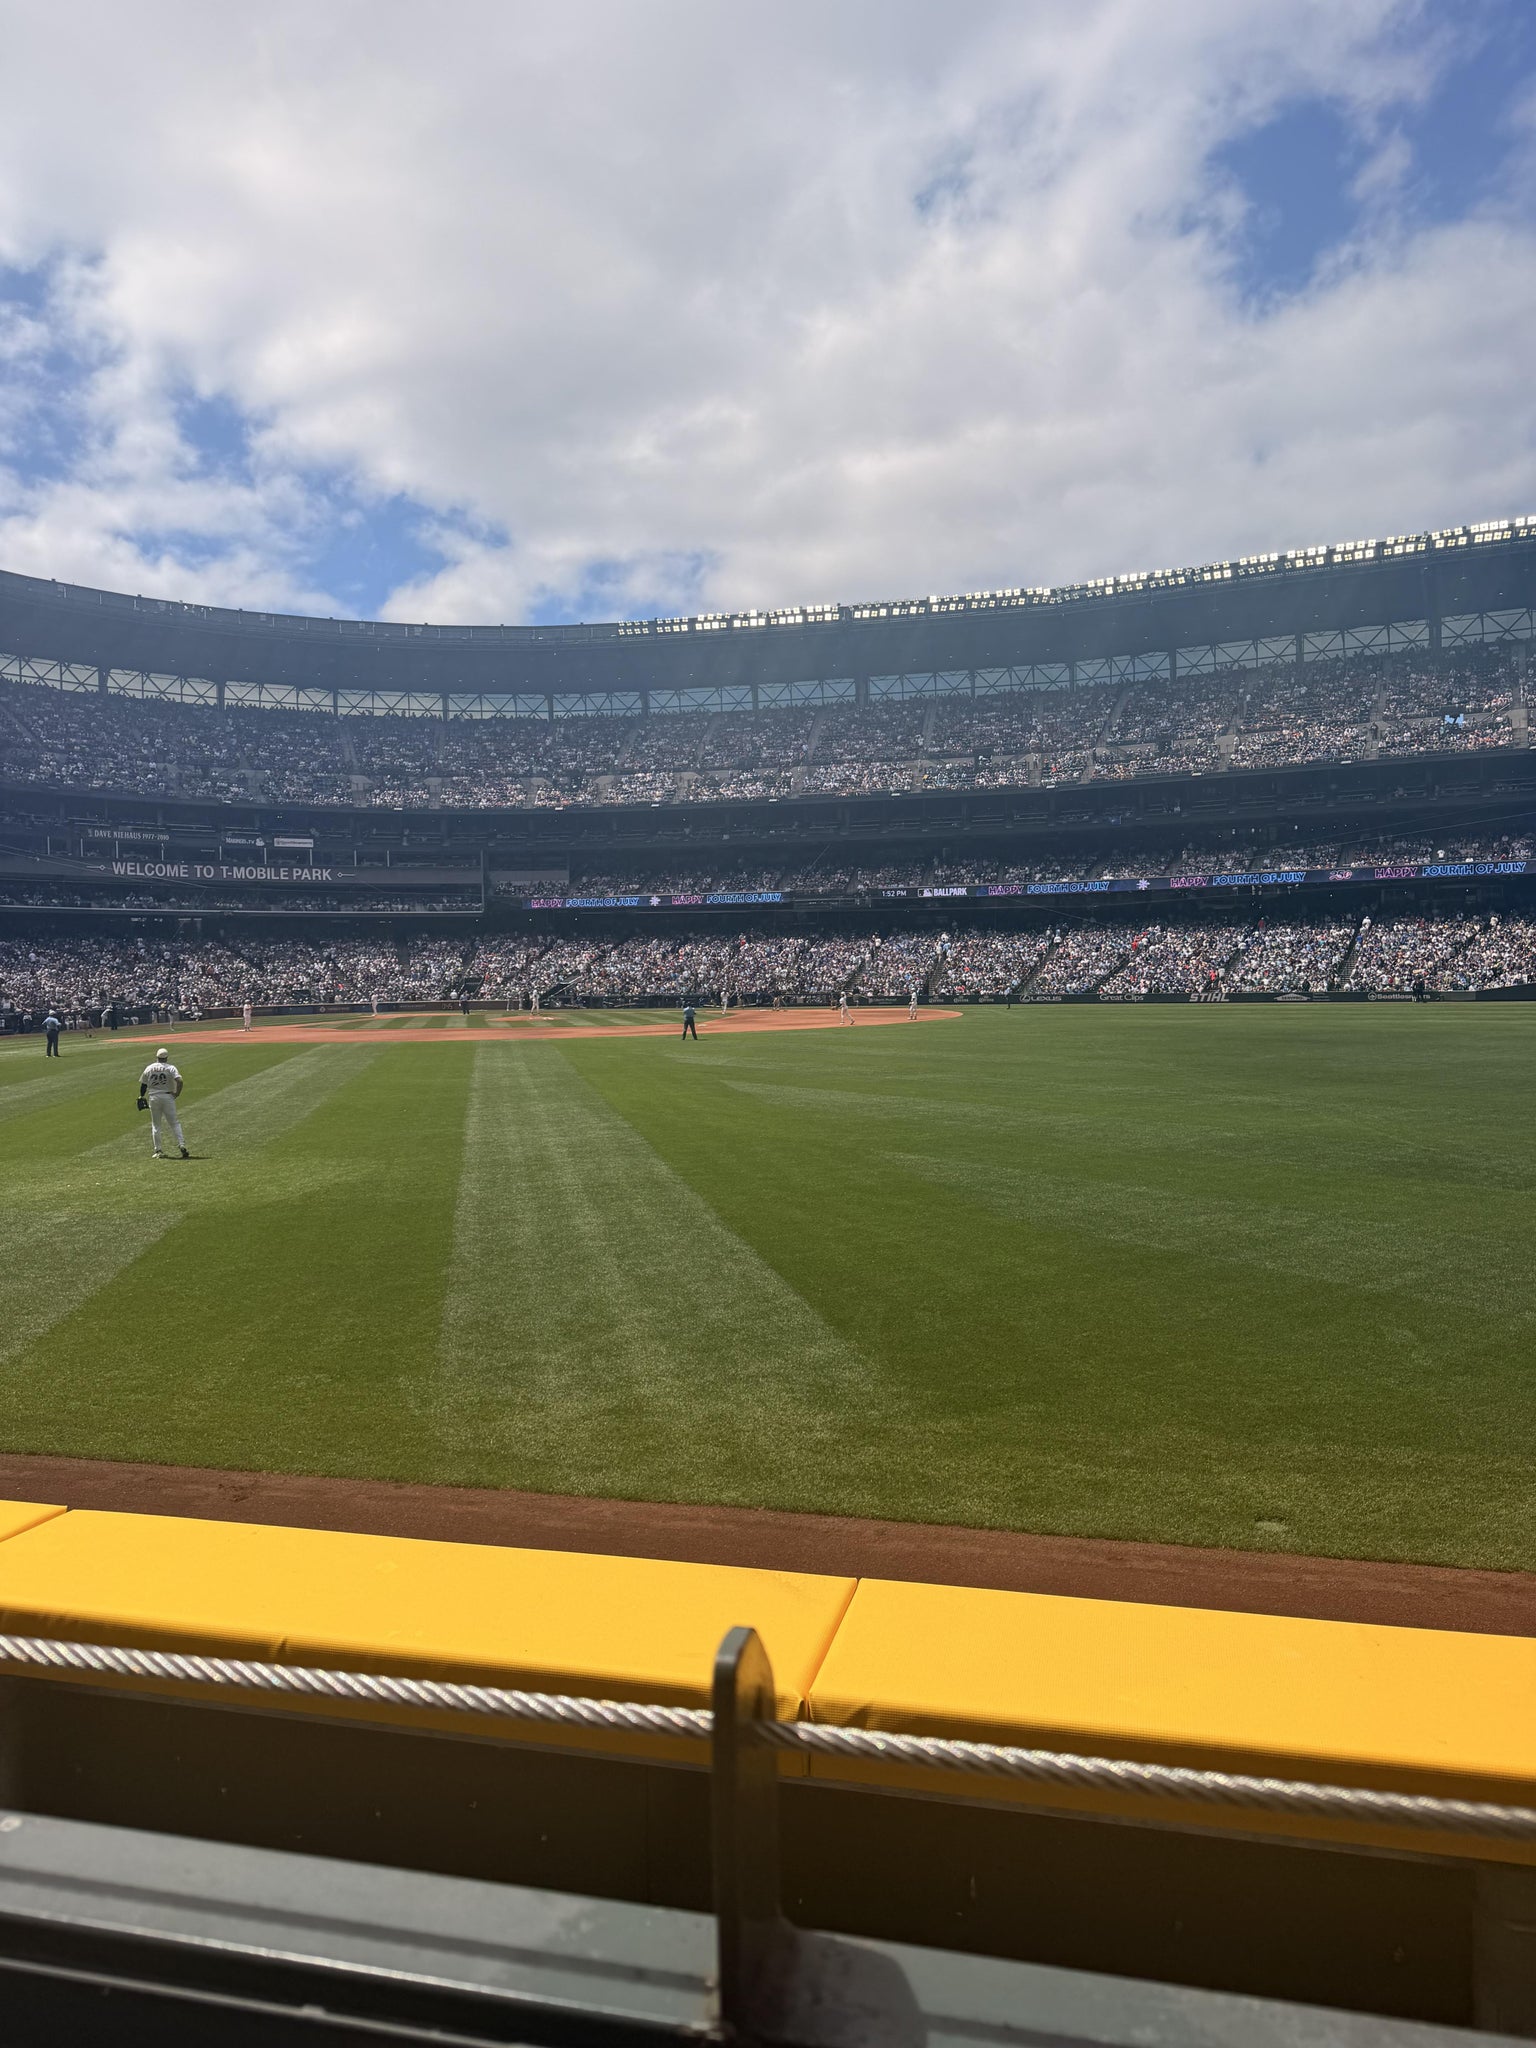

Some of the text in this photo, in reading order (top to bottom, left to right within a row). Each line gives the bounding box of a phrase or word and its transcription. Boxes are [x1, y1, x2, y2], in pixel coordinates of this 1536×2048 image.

[94, 830, 169, 841] DAVE NIEHAUS 1977-2010
[112, 861, 332, 881] WELCOME TO T-MOBILE PARK
[1374, 862, 1526, 878] HAPPY FOURTH OF JULY
[1170, 872, 1306, 888] HAPPY FOURTH OF JULY
[934, 887, 967, 896] BALLPARK
[988, 881, 1110, 895] HAPPY FOURTH OF JULY
[532, 897, 639, 908] HAPPY FOURTH OF JULY
[672, 892, 781, 904] HAPPY FOURTH OF JULY
[1100, 993, 1144, 1002] Great Clips
[1189, 992, 1229, 1002] STIHL
